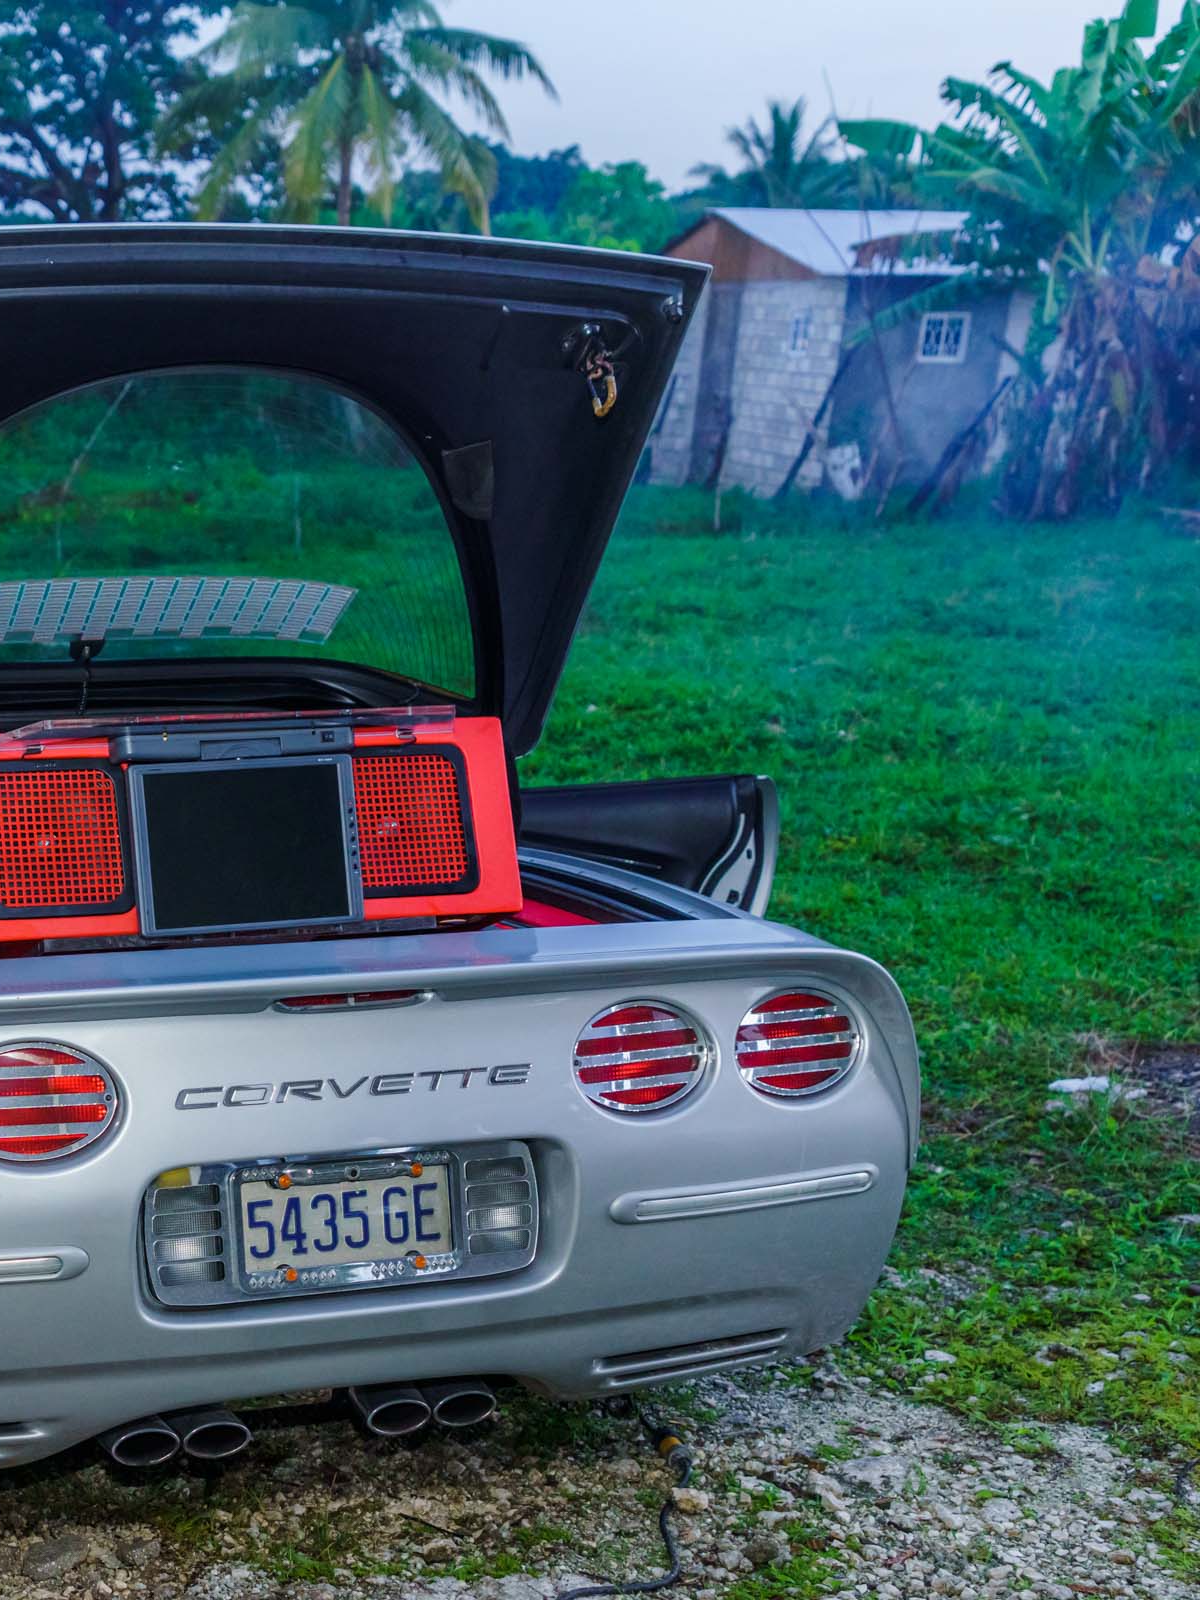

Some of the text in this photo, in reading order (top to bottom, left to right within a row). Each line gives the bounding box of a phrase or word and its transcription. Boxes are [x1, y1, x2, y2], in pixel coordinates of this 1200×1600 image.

[175, 1063, 533, 1111] CORVETTE
[247, 1182, 441, 1260] 5435 GE
